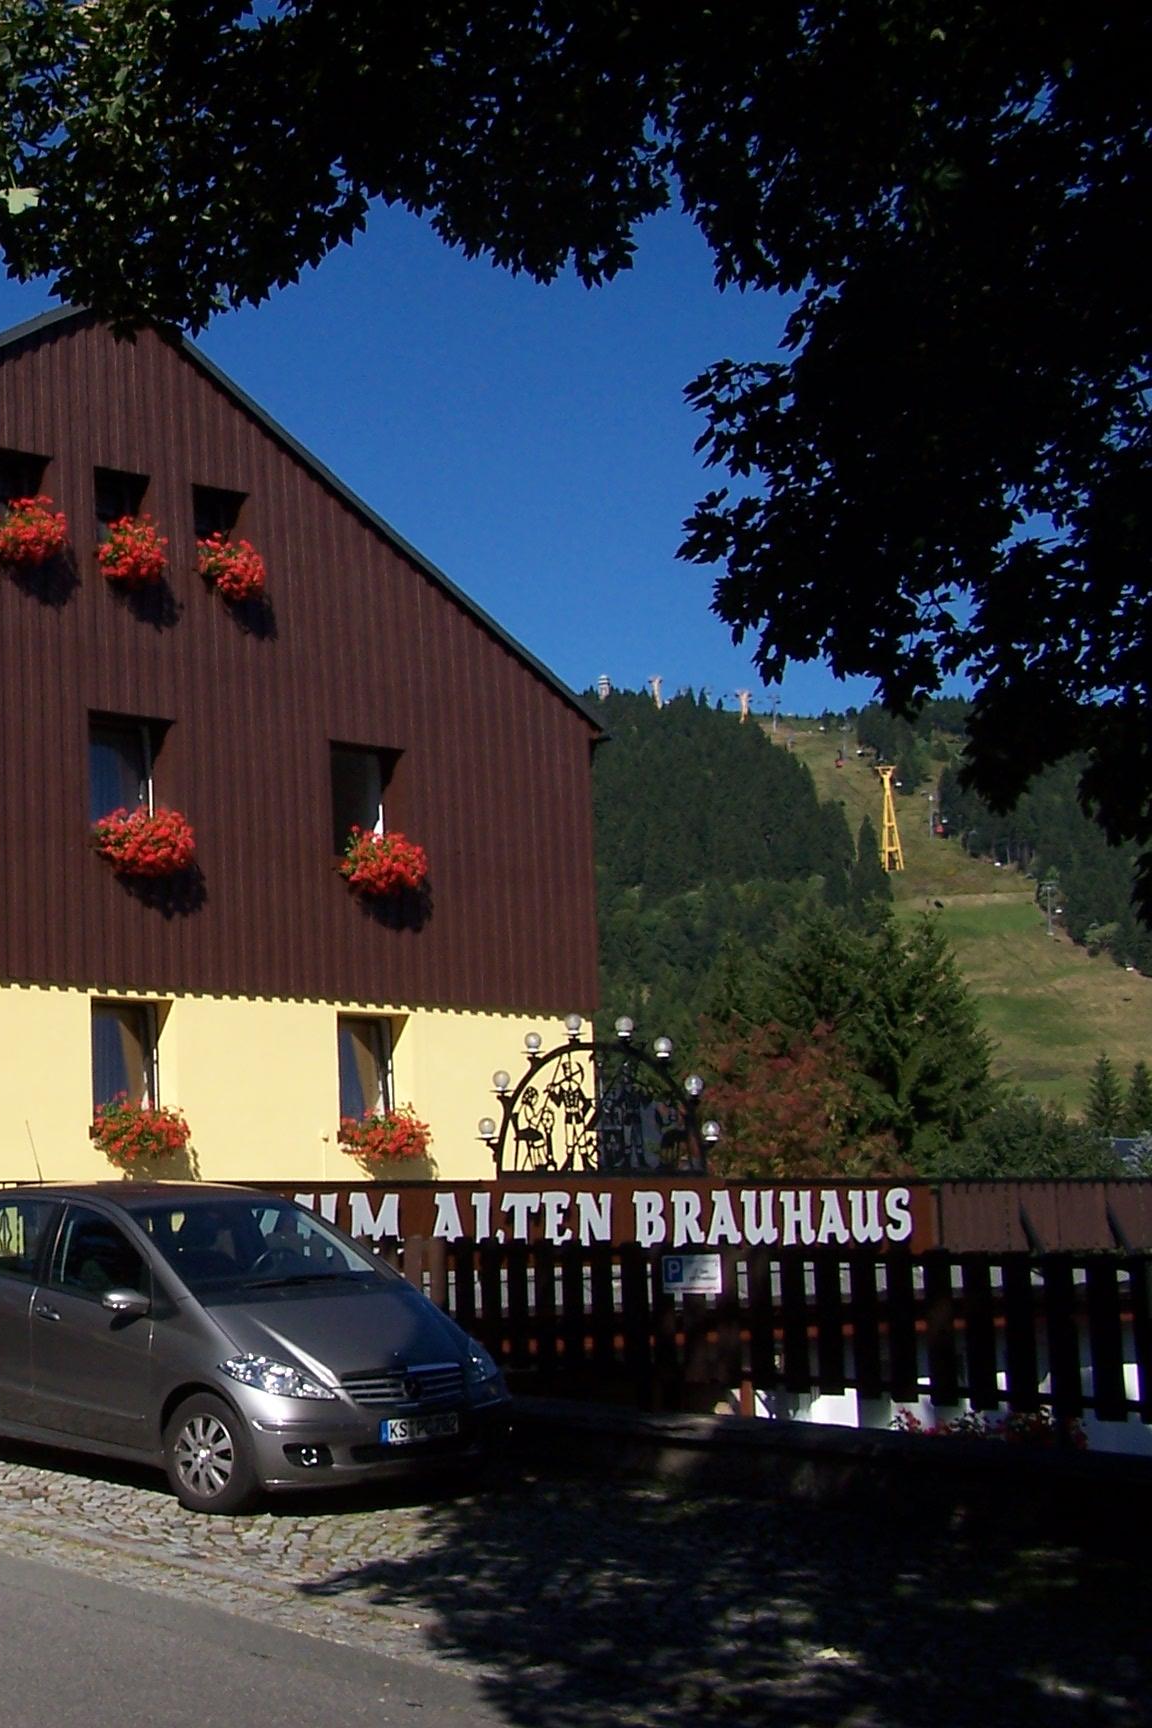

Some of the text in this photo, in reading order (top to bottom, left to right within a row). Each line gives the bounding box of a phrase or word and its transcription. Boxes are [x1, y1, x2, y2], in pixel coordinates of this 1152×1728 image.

[432, 1191, 612, 1247] ALTEN
[632, 1187, 913, 1248] BRAUHAUS
[389, 1421, 408, 1439] KS
